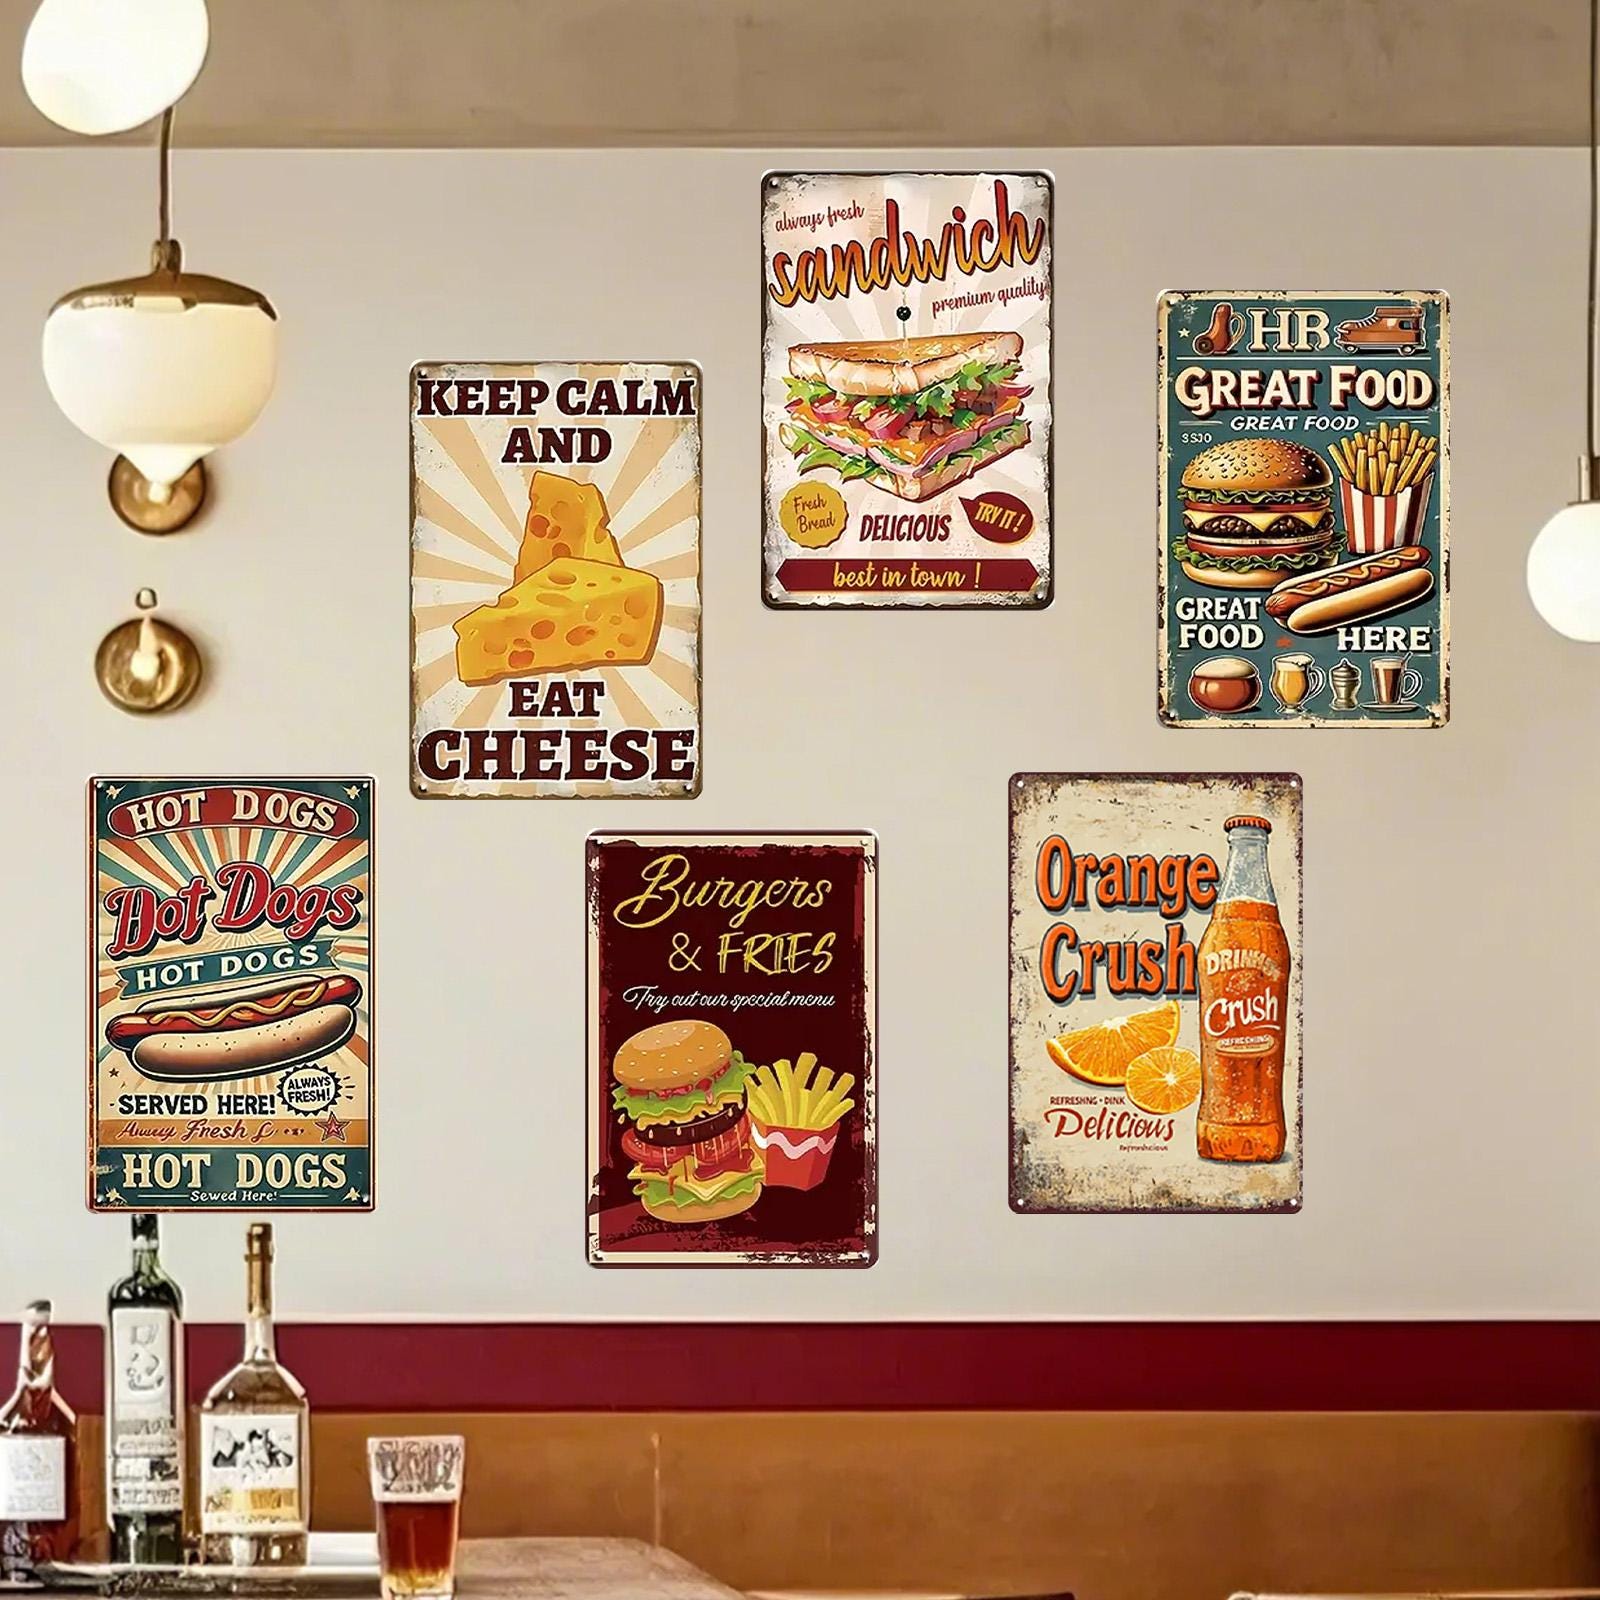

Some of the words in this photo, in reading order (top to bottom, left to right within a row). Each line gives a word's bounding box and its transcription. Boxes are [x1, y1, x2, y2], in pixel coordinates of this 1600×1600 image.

[775, 211, 825, 233] always
[827, 200, 865, 227] fresh
[769, 179, 1046, 308] sandwich
[932, 291, 995, 318] premium
[997, 275, 1046, 305] quality
[416, 380, 550, 416] KEEP
[556, 380, 697, 416] CALM
[1230, 416, 1298, 431] GREAT
[1303, 416, 1360, 430] FOOD
[501, 427, 612, 464] AND
[793, 494, 828, 512] Fresh
[974, 501, 1003, 524] TRY
[1000, 504, 1019, 530] IT
[796, 511, 836, 534] Bread
[859, 513, 952, 542] DELICIOUS
[832, 561, 876, 588] best
[881, 564, 907, 586] in
[910, 563, 966, 588] town
[1175, 597, 1261, 620] GREAT
[1178, 623, 1264, 649] FOOD
[1337, 627, 1431, 651] HERE
[508, 681, 605, 717] EAT
[417, 729, 696, 781] CHEESE
[126, 791, 206, 833] HOT
[231, 789, 338, 832] DOGS
[613, 853, 832, 929] Burgers
[1035, 834, 1220, 918] Orange
[212, 861, 364, 943] Dogs
[136, 961, 204, 991] HOT
[220, 943, 320, 977] DOGS
[668, 932, 702, 972] &
[717, 931, 837, 976] FRIES
[1039, 922, 1198, 1003] Crush
[622, 985, 669, 1014] Try
[671, 990, 701, 1007] out
[699, 993, 729, 1007] our
[729, 990, 791, 1013] special
[787, 994, 836, 1007] menu
[1203, 986, 1279, 1037] Crush
[287, 1076, 332, 1090] ALWAYS
[288, 1088, 331, 1103] FRESH!
[118, 1094, 208, 1115] SERVED
[217, 1094, 276, 1115] HERE!
[122, 1153, 212, 1188] HOT
[235, 1153, 347, 1188] DOGS
